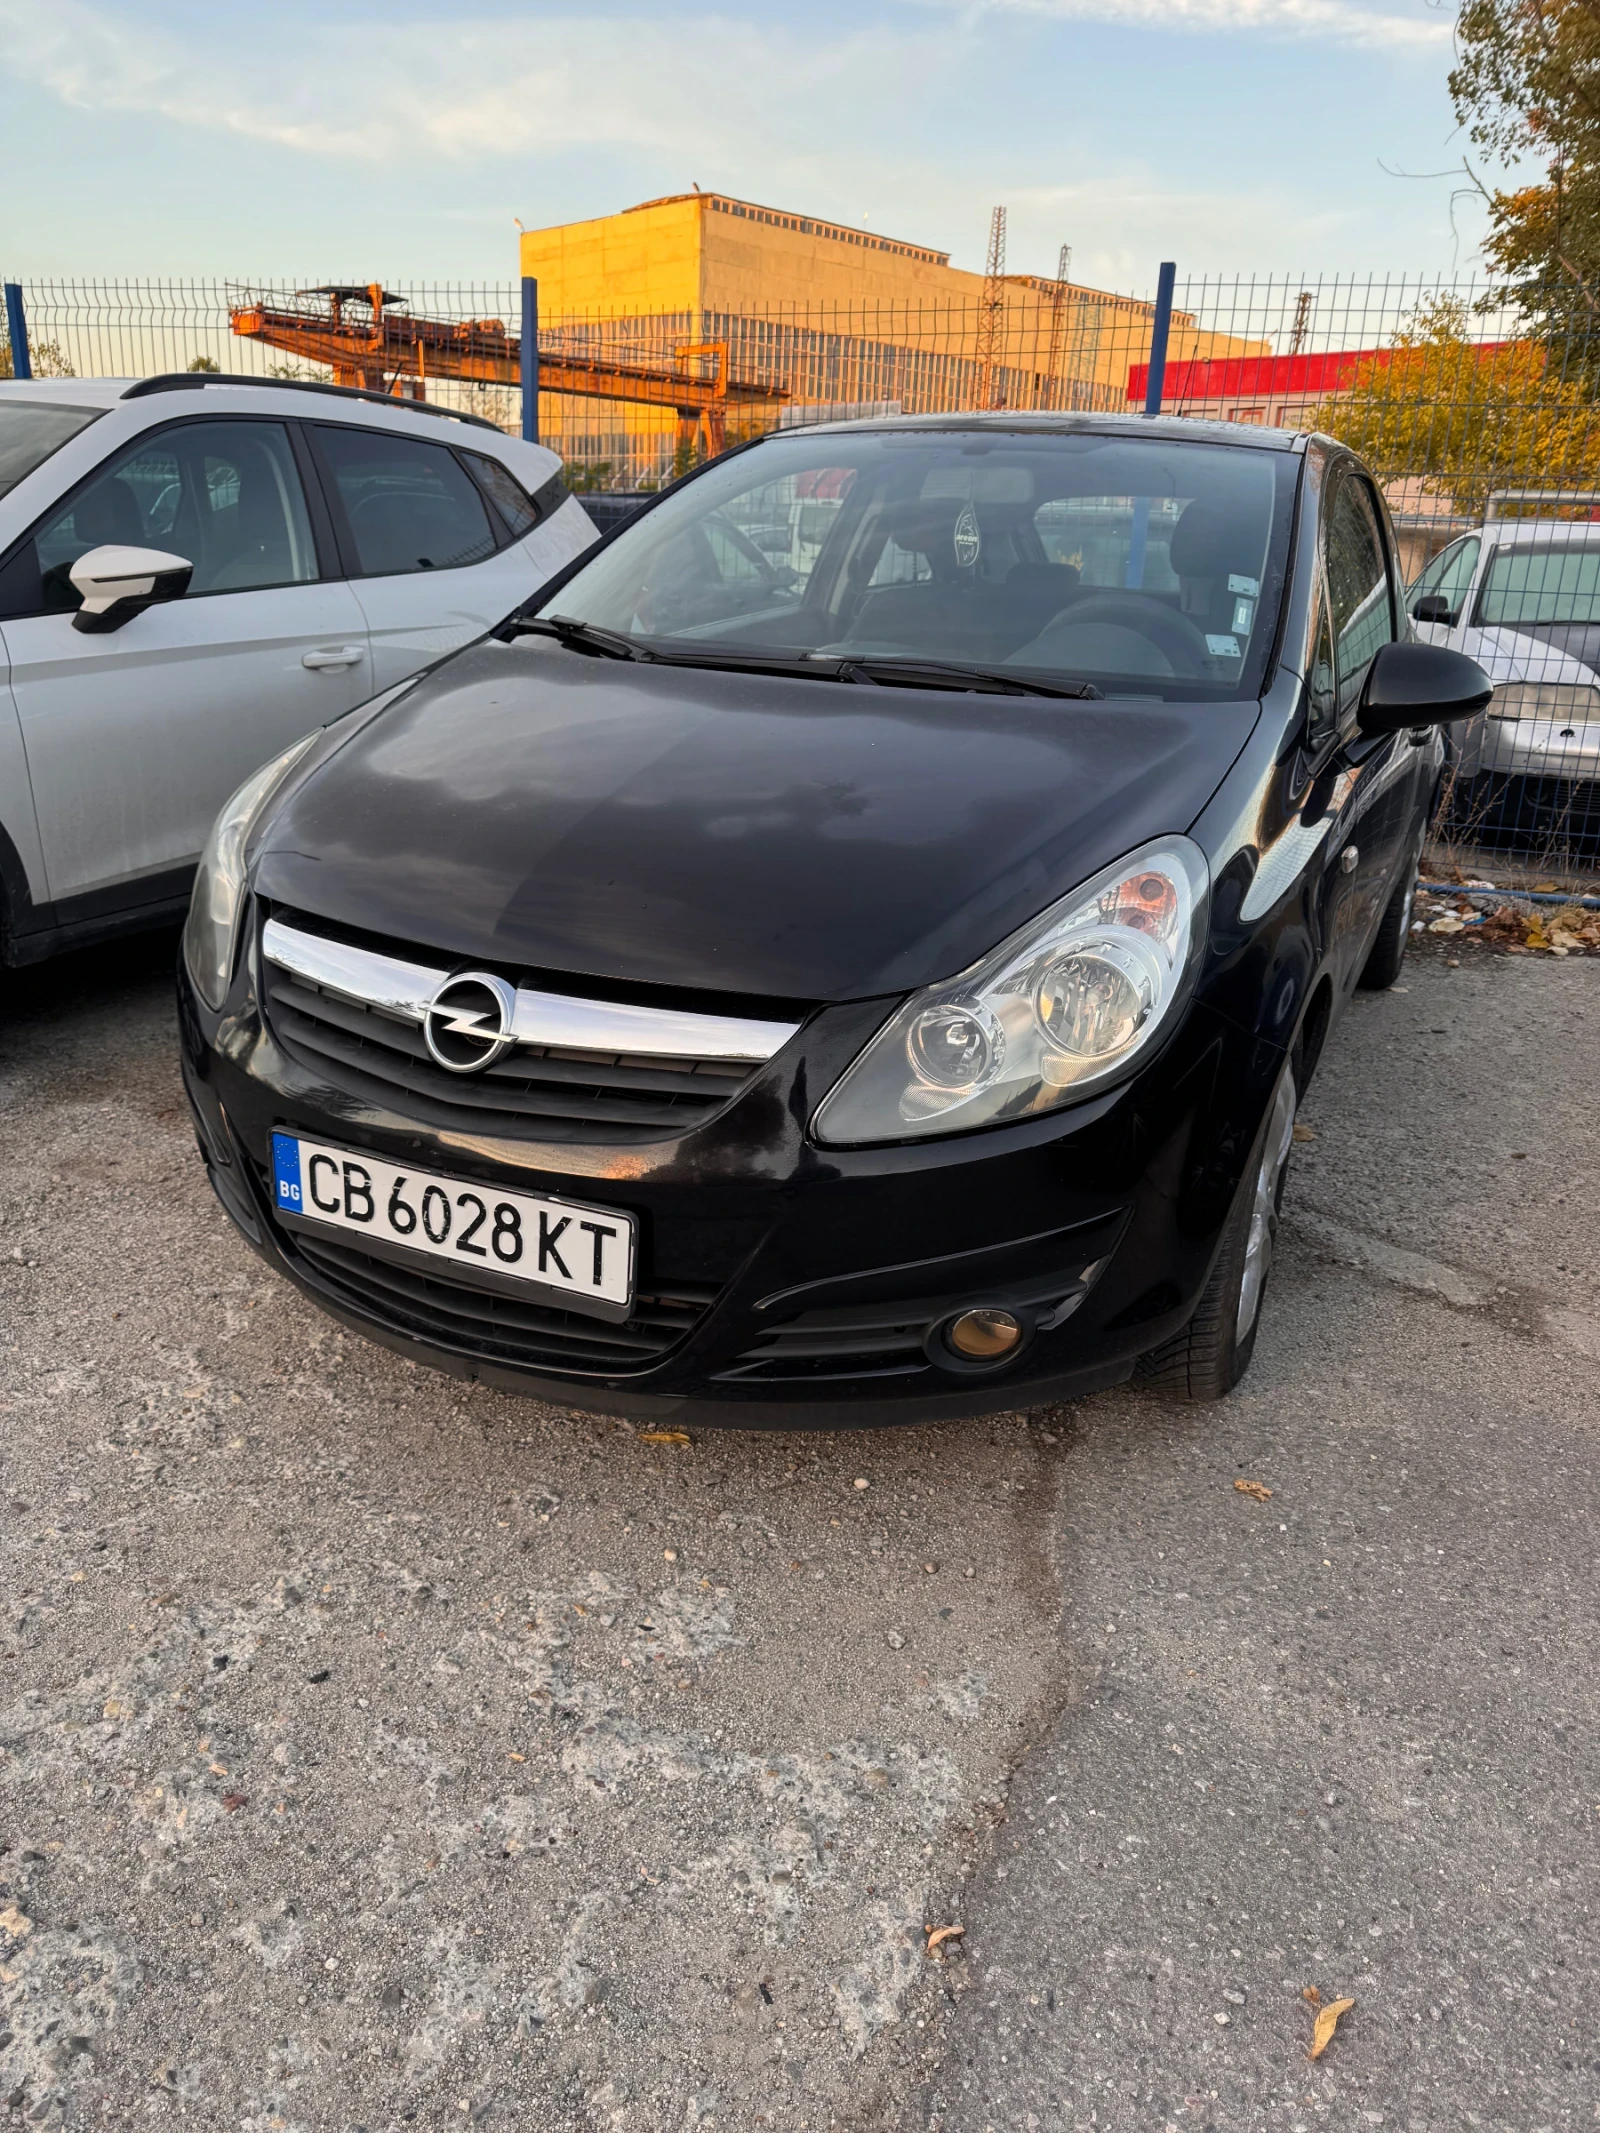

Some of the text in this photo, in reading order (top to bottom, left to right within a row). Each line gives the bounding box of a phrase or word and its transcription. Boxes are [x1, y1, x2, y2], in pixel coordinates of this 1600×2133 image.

[279, 1181, 301, 1201] BG
[309, 1153, 616, 1286] CB 6028 KT
